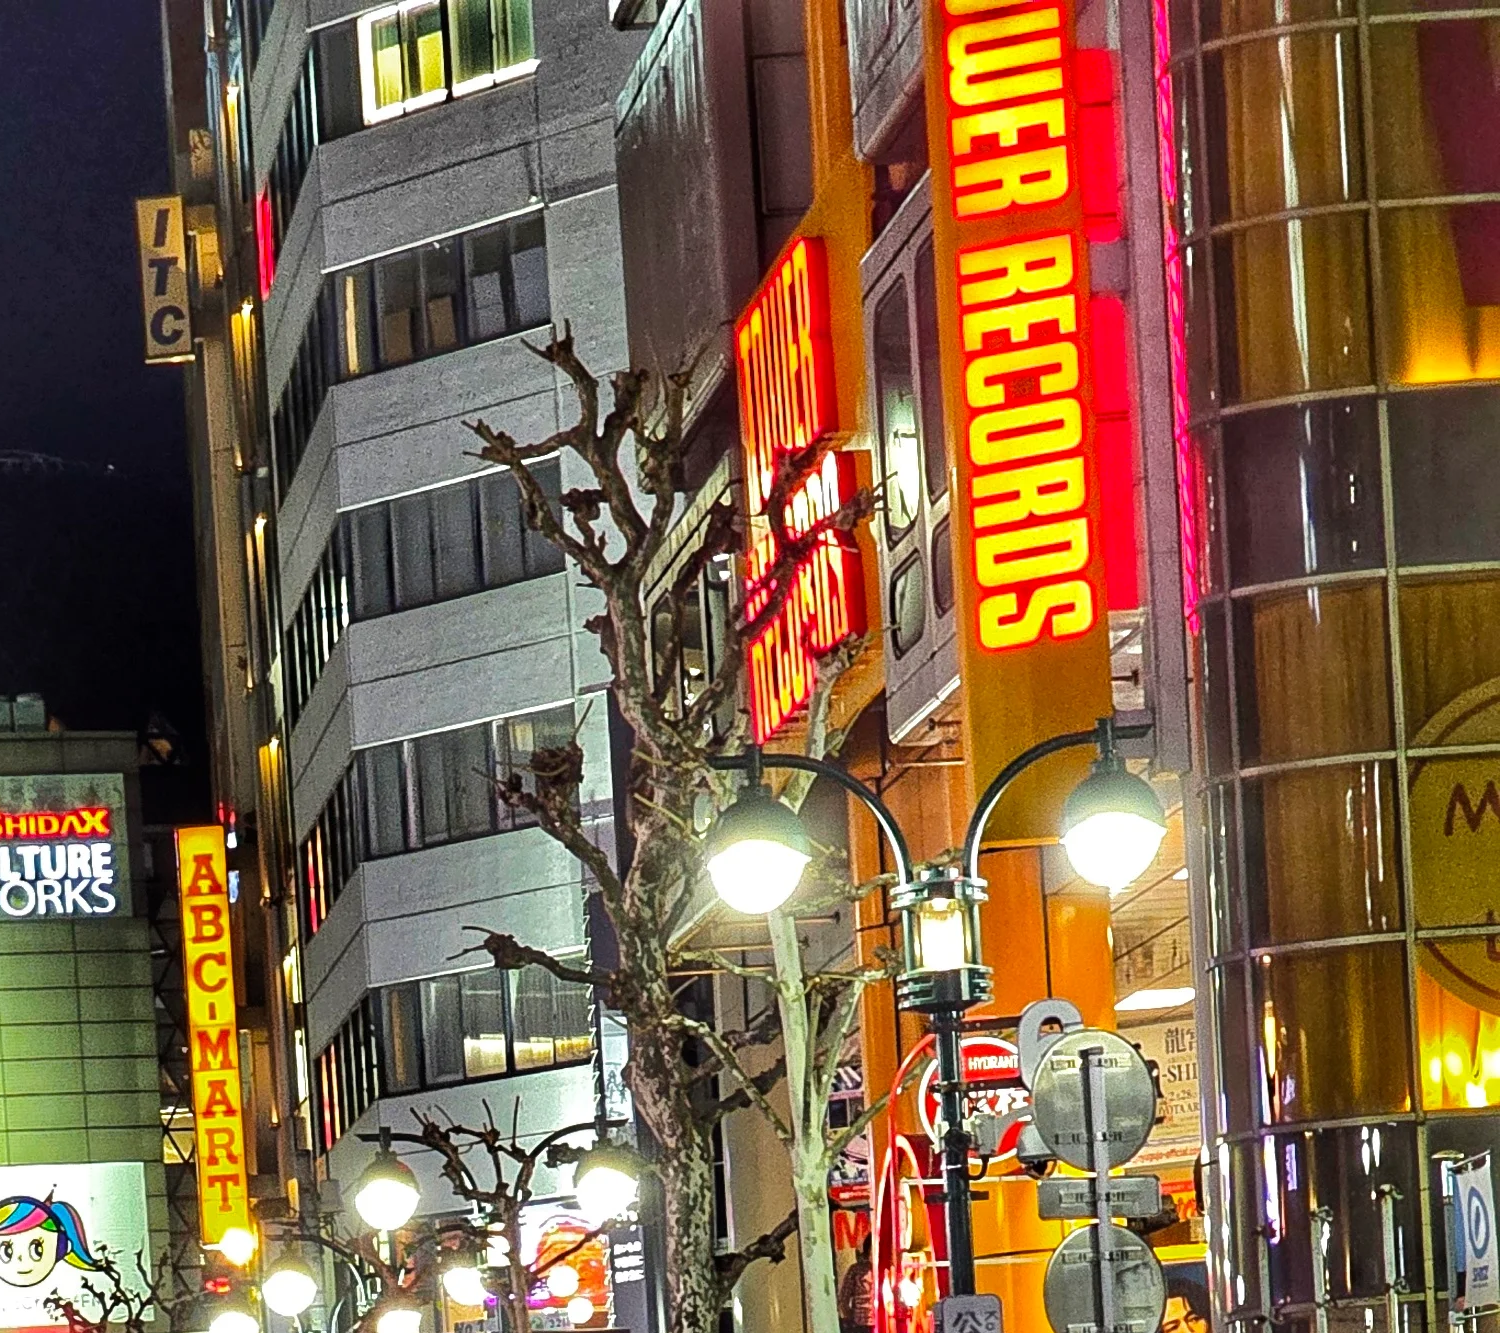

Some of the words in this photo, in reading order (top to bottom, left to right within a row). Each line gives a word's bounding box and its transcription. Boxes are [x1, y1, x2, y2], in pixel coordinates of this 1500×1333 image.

[941, 0, 1073, 217] WER
[147, 206, 184, 346] ITC
[956, 232, 1094, 650] RECORDS
[185, 853, 246, 1213] ABC-MART
[968, 1055, 1019, 1070] HYDRANT
